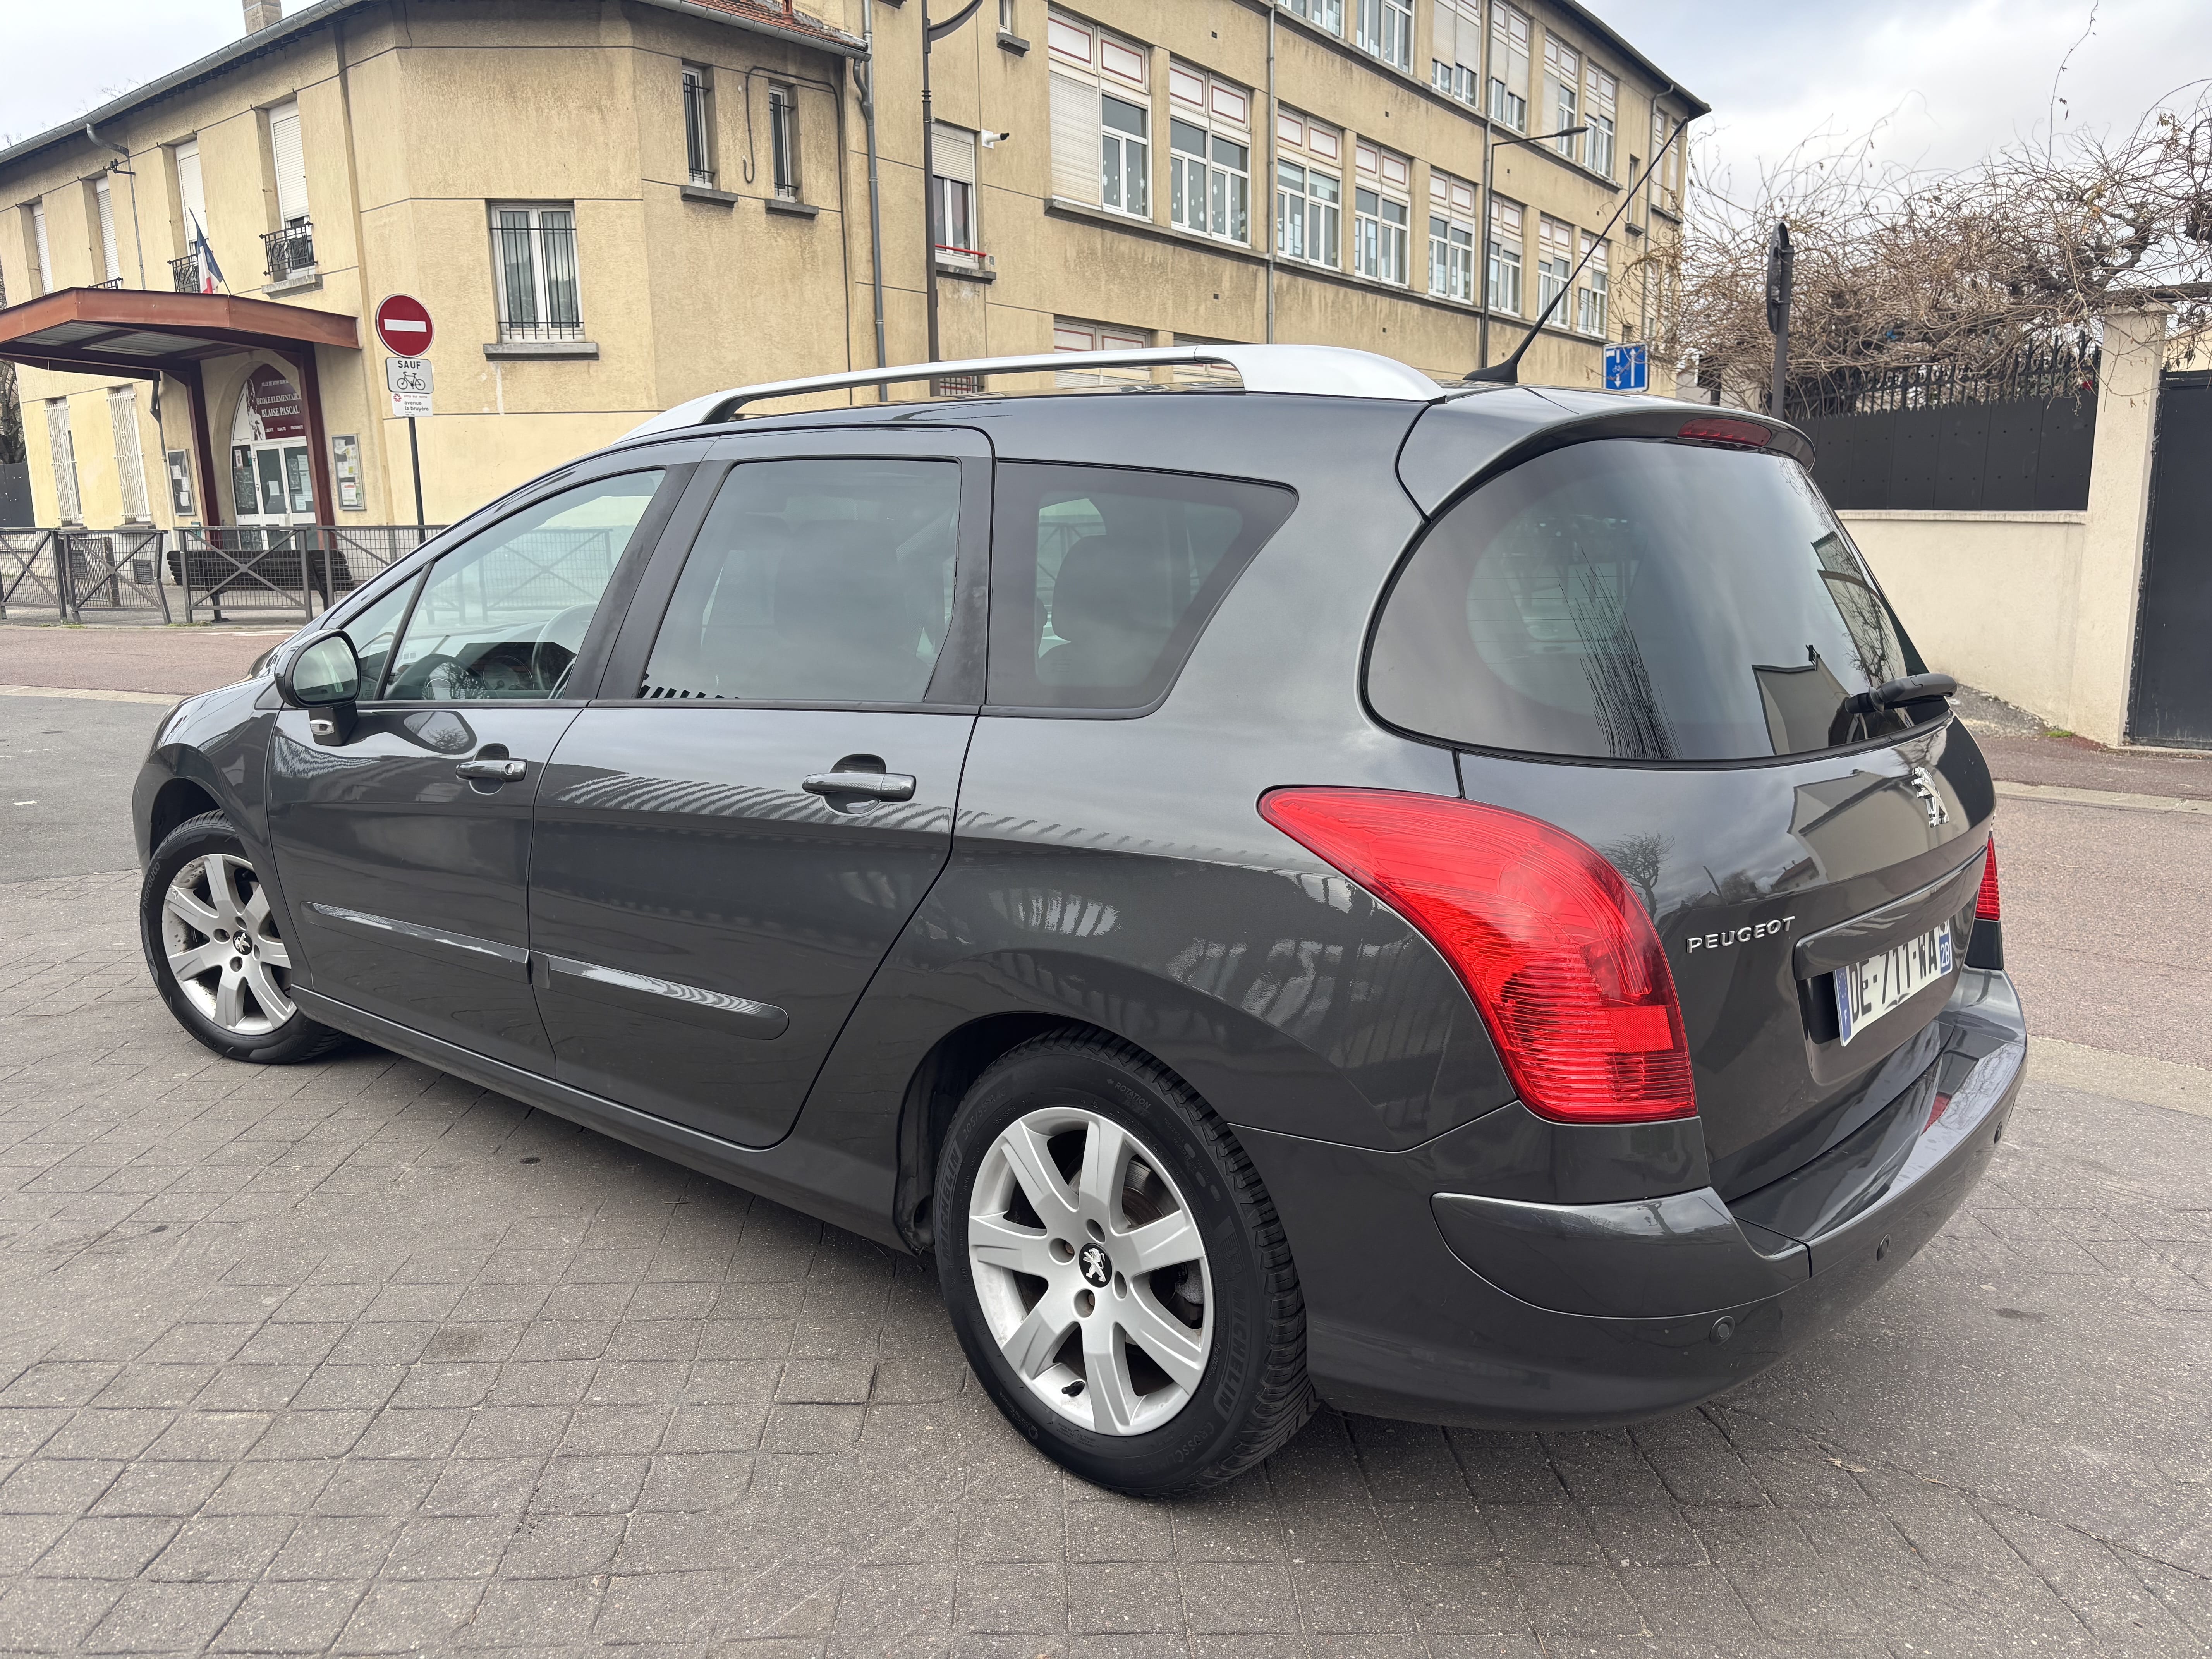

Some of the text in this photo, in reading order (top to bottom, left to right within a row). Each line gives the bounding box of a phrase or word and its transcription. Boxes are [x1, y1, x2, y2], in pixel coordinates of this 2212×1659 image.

[398, 360, 421, 369] SAUF
[257, 397, 271, 405] ECOLE
[261, 405, 300, 418] BLAISE PASCAL
[143, 862, 160, 908] Norauto
[1687, 916, 1795, 953] PEUGEOT
[1844, 929, 1950, 1027] F DE-711-WA 2B
[1115, 1082, 1151, 1109] ROTATION
[941, 1147, 959, 1257] MICHELIN
[1218, 1285, 1247, 1413] MICHELIN
